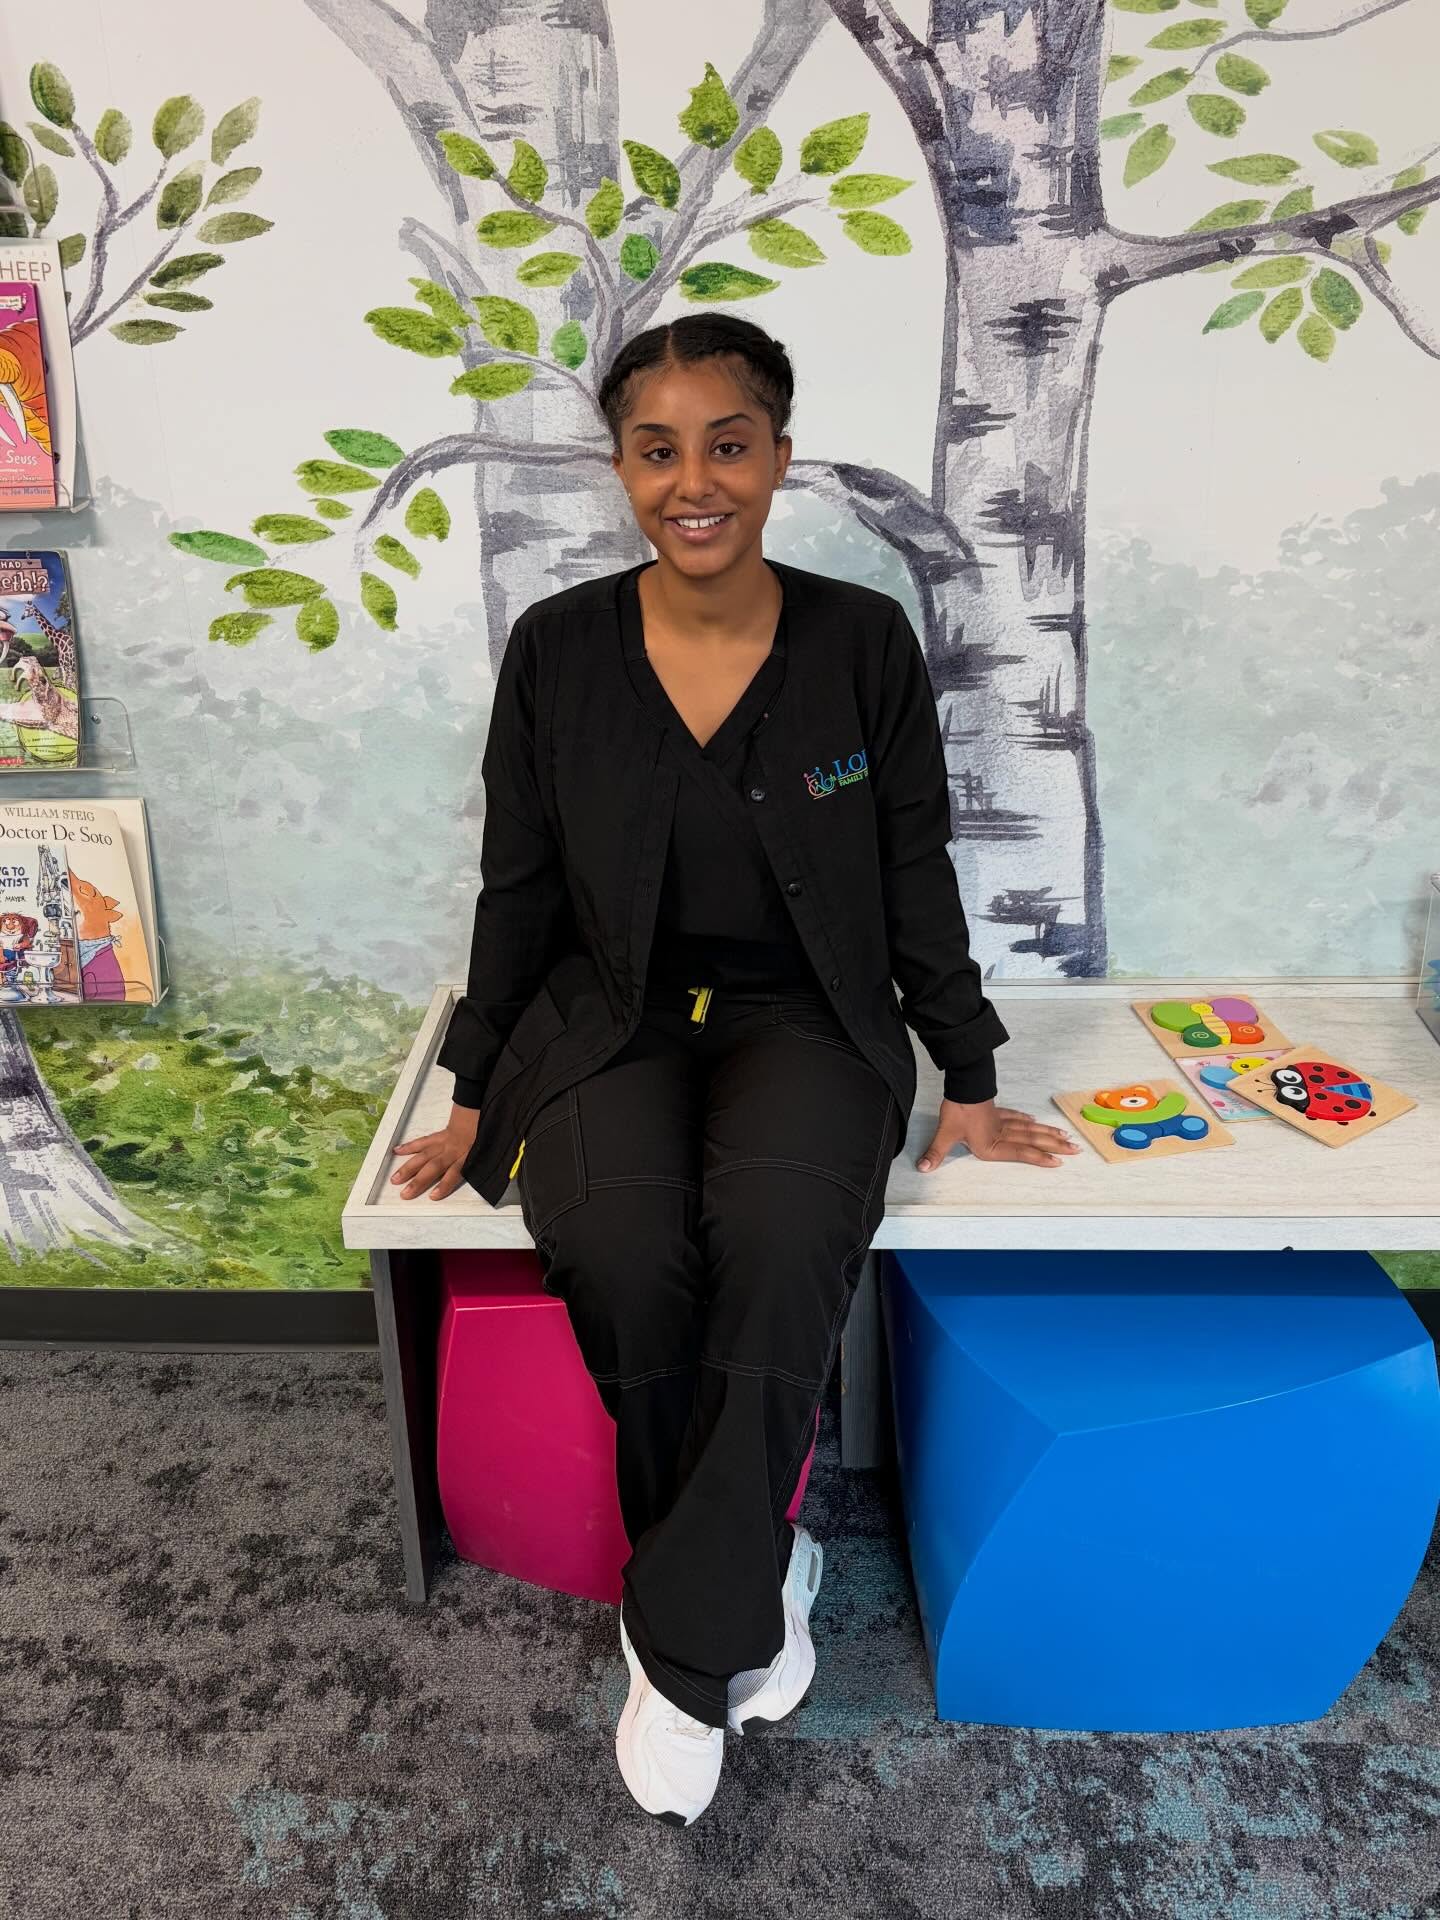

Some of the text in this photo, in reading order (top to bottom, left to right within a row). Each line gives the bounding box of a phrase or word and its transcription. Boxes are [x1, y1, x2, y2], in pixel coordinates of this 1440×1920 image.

[5, 449, 38, 466] Seuss
[0, 561, 21, 569] HAD
[839, 773, 864, 787] FAMILY
[5, 807, 95, 821] WILLIAM STEIG
[53, 824, 75, 841] De
[80, 826, 113, 846] Soto
[11, 866, 25, 877] TO
[5, 895, 26, 903] MAYER
